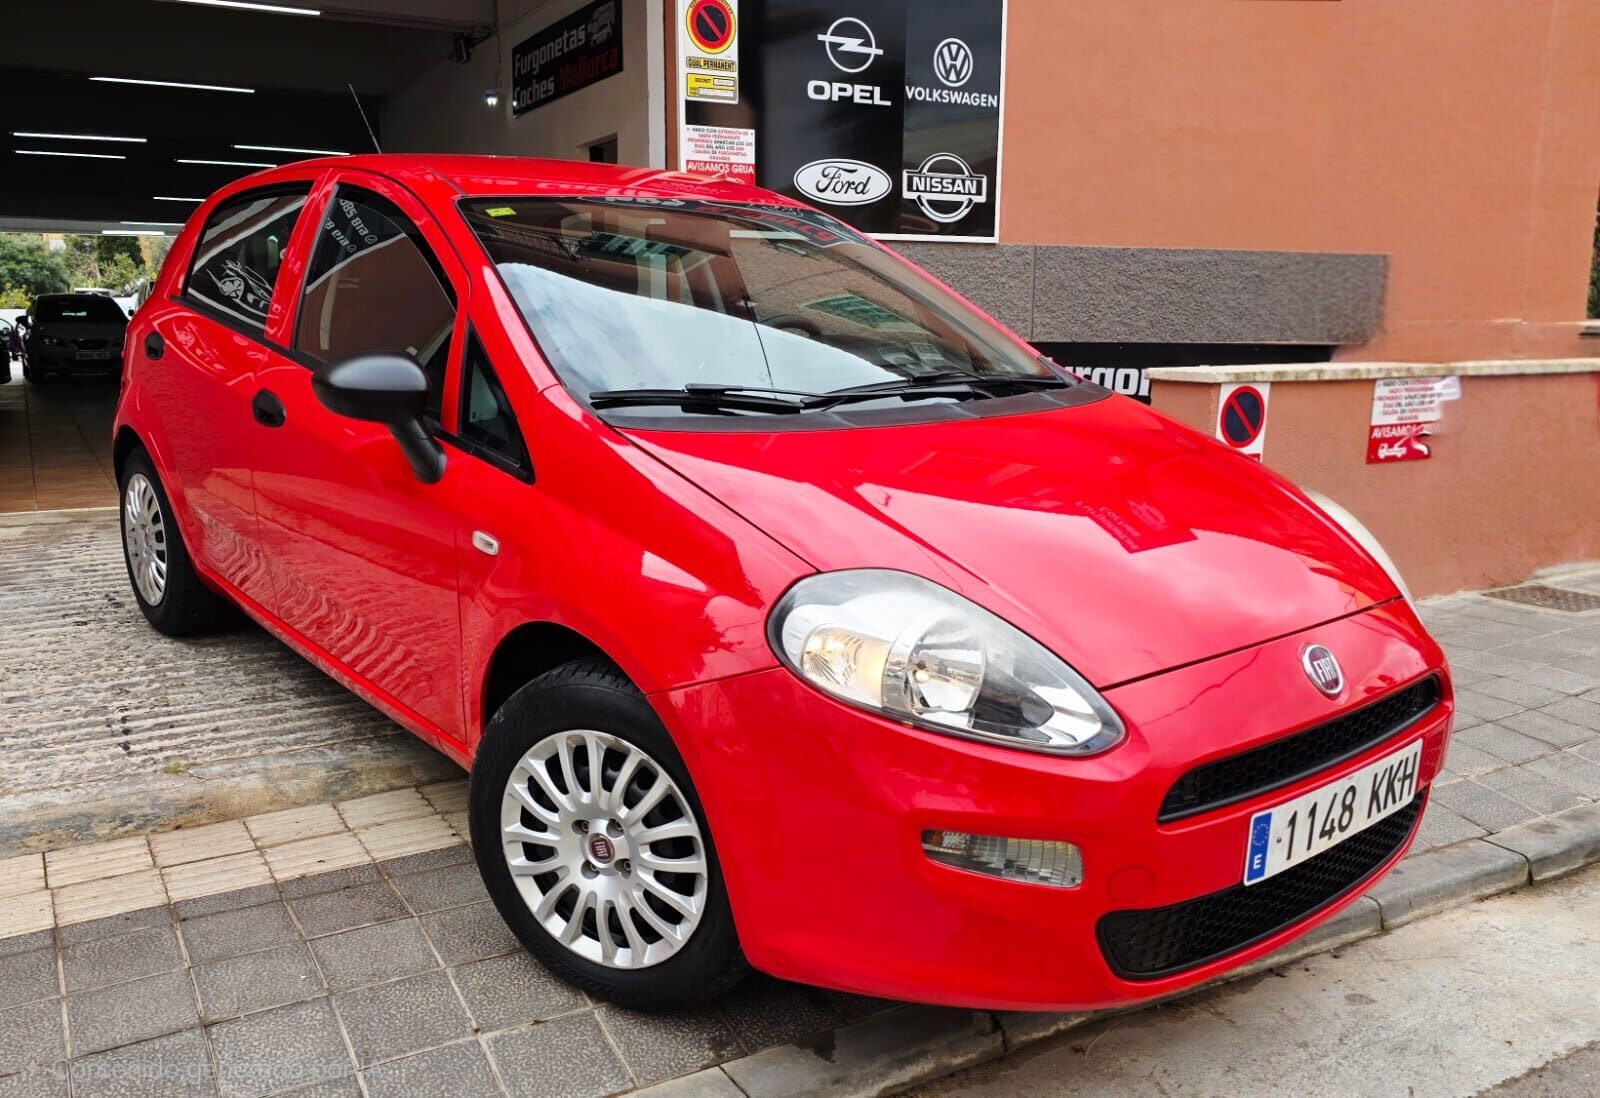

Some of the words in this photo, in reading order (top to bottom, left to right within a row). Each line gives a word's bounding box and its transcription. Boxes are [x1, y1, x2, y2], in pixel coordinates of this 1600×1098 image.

[514, 24, 587, 78] Furgonetas
[703, 59, 736, 71] PERMANENT
[514, 76, 555, 110] Coches
[559, 47, 619, 90] Mallorca
[807, 79, 892, 107] OPEL
[905, 85, 998, 108] VOLKSWAGEN
[687, 161, 730, 173] AVISAMOS
[816, 165, 872, 196] Ford
[912, 176, 978, 194] NISSAN
[1312, 657, 1337, 683] FIAT
[1286, 785, 1357, 861] 1148
[1367, 751, 1418, 819] KKH
[1253, 854, 1262, 870] E
